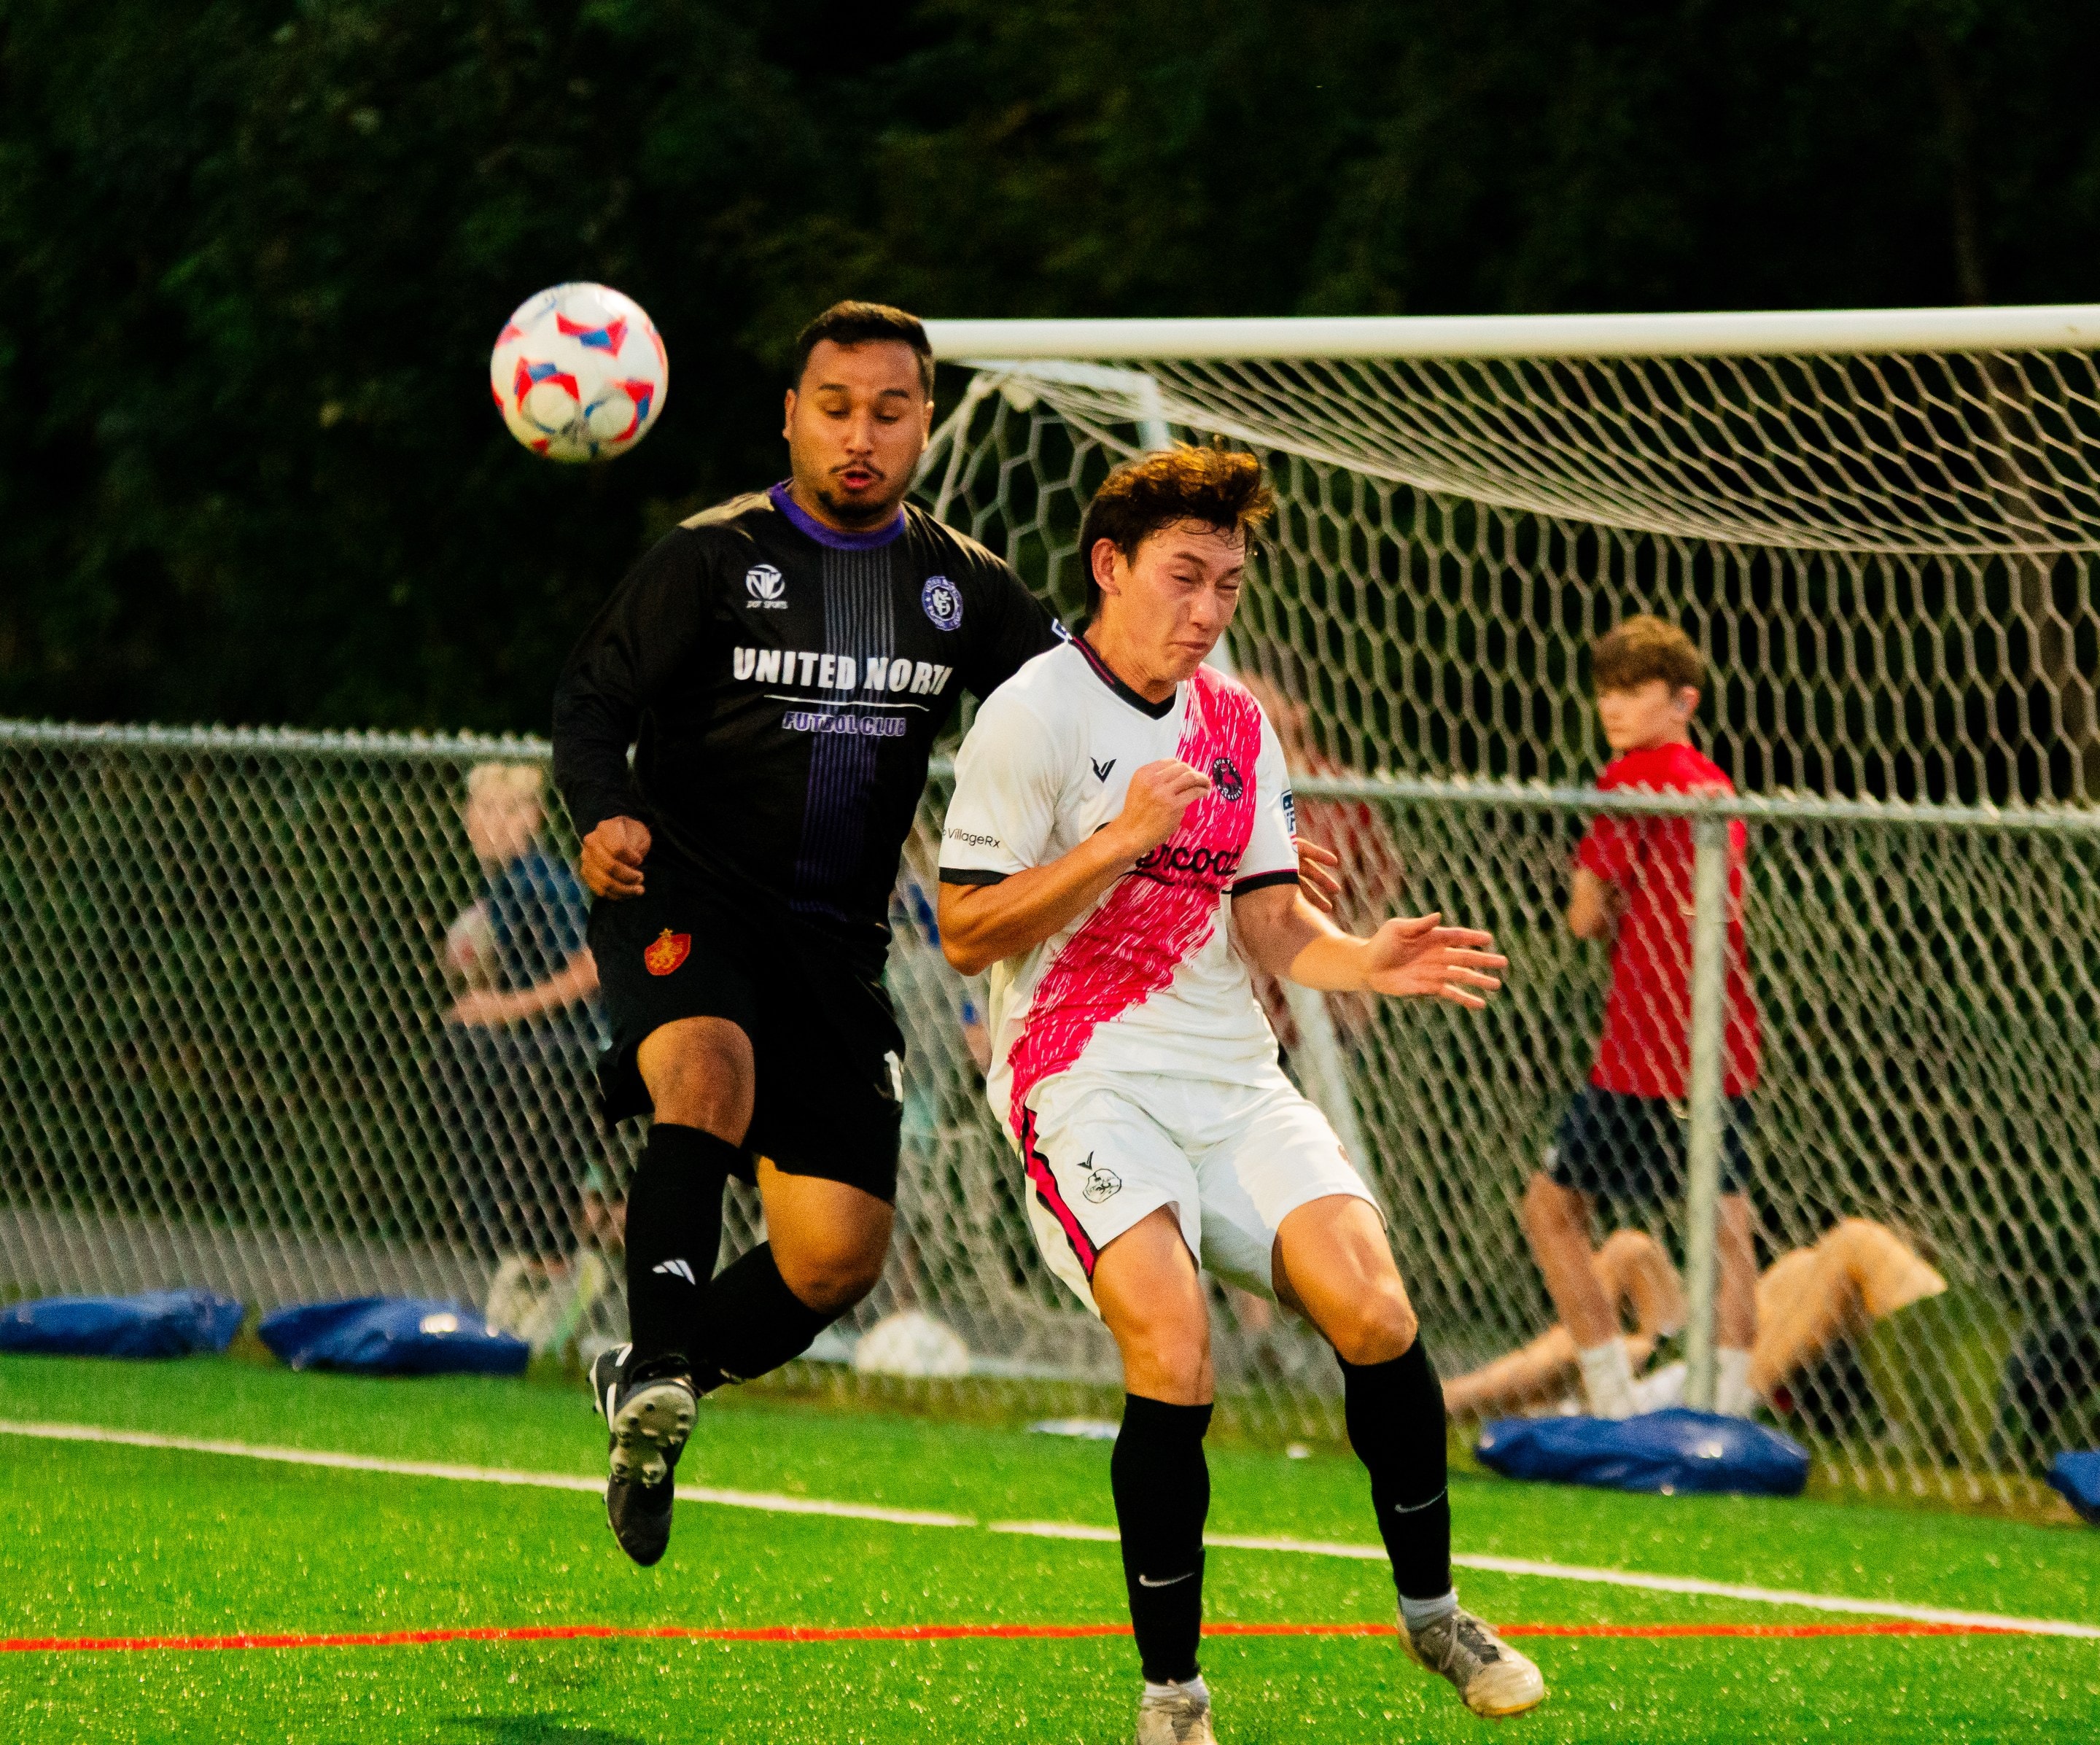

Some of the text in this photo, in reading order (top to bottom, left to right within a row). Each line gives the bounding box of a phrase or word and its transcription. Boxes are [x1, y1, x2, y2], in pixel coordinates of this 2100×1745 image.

[733, 646, 856, 690] UNITED
[859, 716, 906, 737] CLUB
[948, 828, 1000, 848] VillageRx
